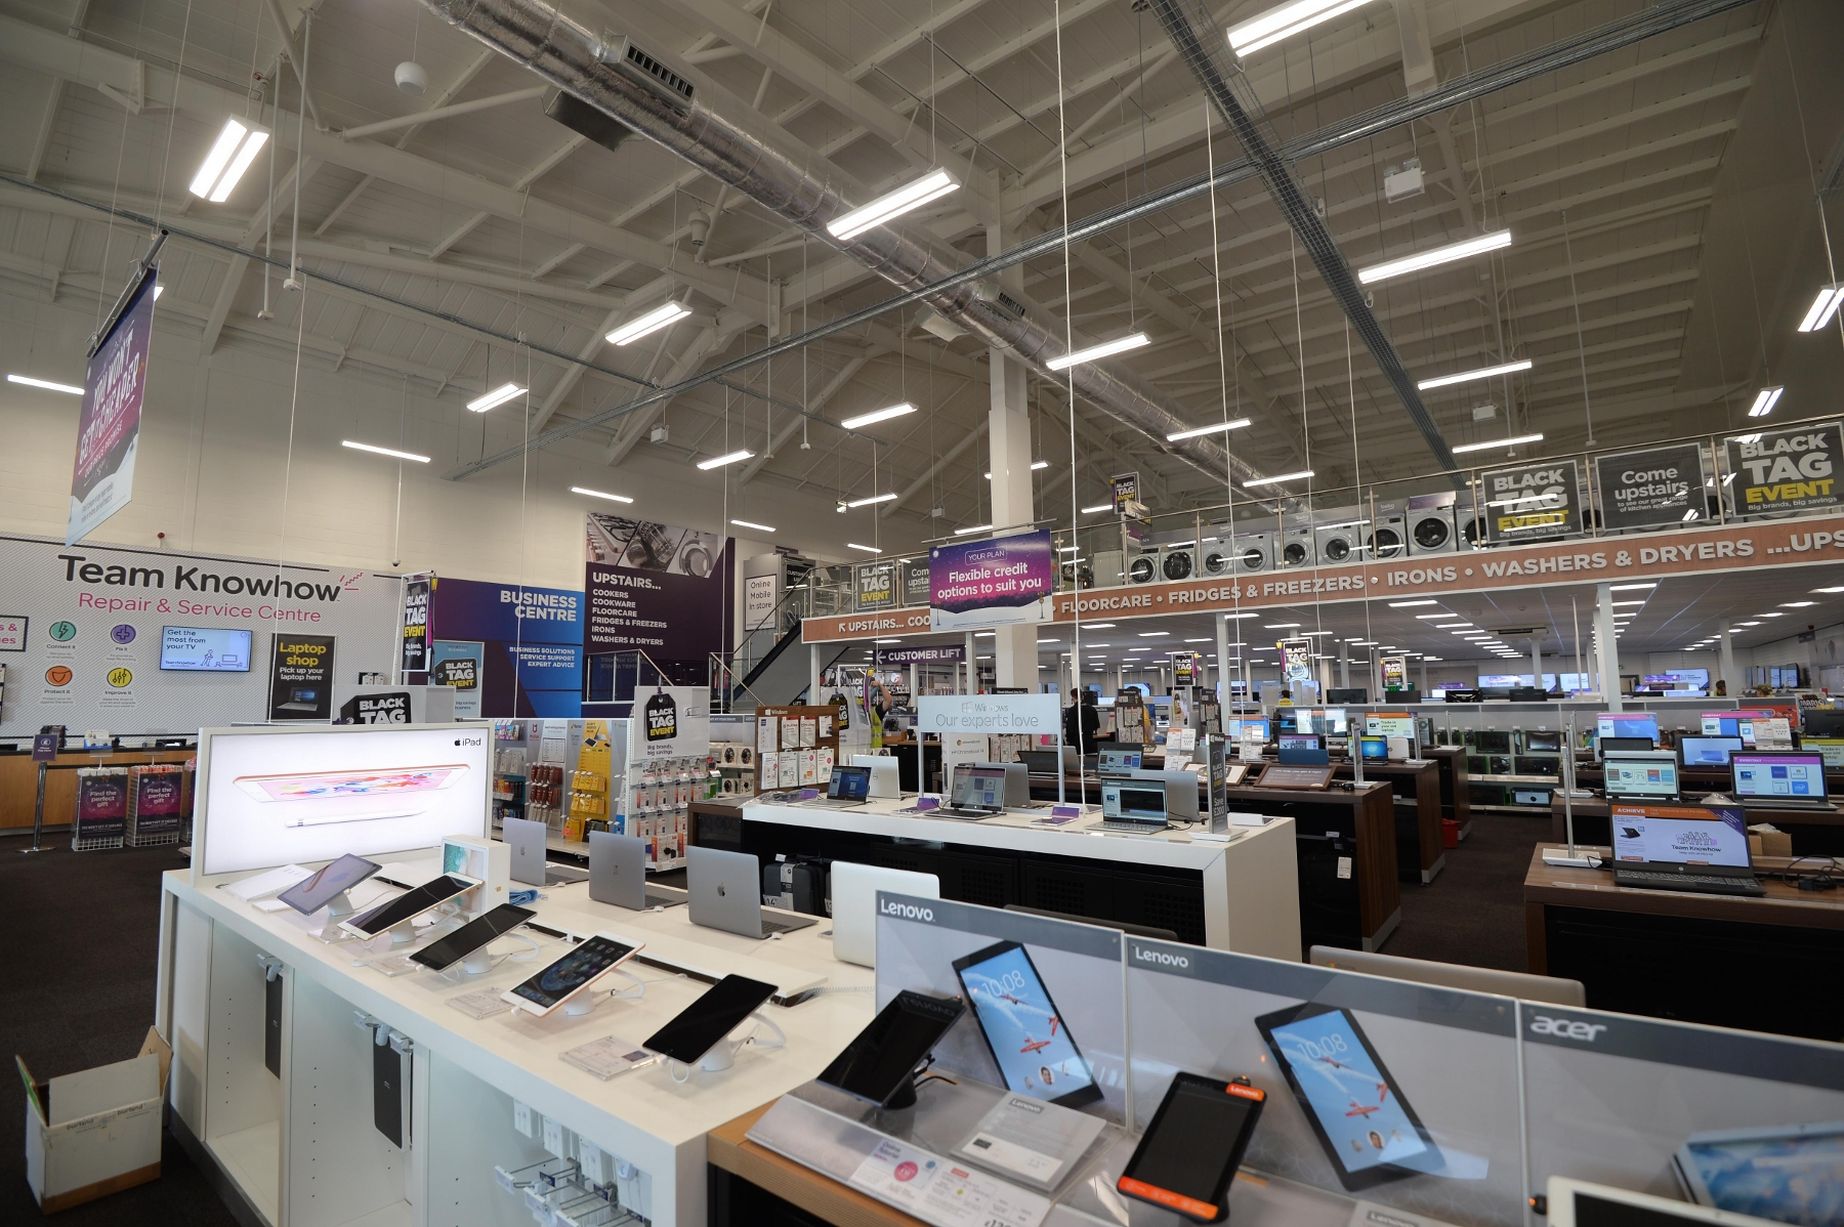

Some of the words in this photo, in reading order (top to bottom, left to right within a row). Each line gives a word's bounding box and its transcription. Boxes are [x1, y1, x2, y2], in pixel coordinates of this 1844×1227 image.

[1740, 433, 1828, 458] BLACK
[1742, 452, 1832, 484] TAG
[1494, 469, 1566, 491] BLACK
[1622, 468, 1678, 484] Come
[1117, 486, 1134, 496] TAG
[1614, 480, 1688, 502] upstairs
[1746, 479, 1834, 504] EVENT
[1496, 486, 1568, 514] TAG
[1808, 496, 1837, 505] savings
[1498, 510, 1568, 531] EVENT
[968, 552, 986, 562] YOUR
[987, 550, 1004, 558] PLAN
[1388, 566, 1458, 586] IRONS
[1482, 552, 1608, 578] WASHERS
[1615, 550, 1632, 567] &
[1640, 540, 1754, 564] DRYERS
[861, 565, 889, 577] BLACK
[912, 568, 929, 577] Com
[949, 568, 990, 584] Flexible
[994, 562, 1028, 578] credit
[58, 554, 164, 588] Team
[174, 565, 341, 602] Knowhow
[861, 575, 890, 592] TAG
[592, 588, 629, 598] COOKERS
[938, 585, 978, 600] options
[981, 584, 993, 594] to
[996, 579, 1016, 592] suit
[1020, 578, 1042, 592] you
[1062, 595, 1152, 614] FLOORCARE
[1169, 586, 1242, 604] FRIDGES
[1246, 585, 1258, 598] &
[1264, 576, 1364, 596] FREEZERS
[406, 594, 427, 606] BLACK
[500, 590, 576, 608] BUSINESS
[861, 590, 890, 602] EVENT
[79, 592, 152, 614] Repair
[156, 598, 171, 613] &
[178, 600, 252, 619] Service
[258, 605, 322, 622] Centre
[592, 598, 636, 608] COOKWARE
[406, 606, 426, 626] TAG
[514, 606, 576, 622] CENTRE
[592, 607, 638, 618] FLOORCARE
[8, 623, 18, 632] &
[592, 617, 624, 626] FRIDGES
[632, 620, 668, 628] FREEZERS
[908, 616, 930, 626] COO
[404, 626, 426, 638] EVENT
[592, 626, 616, 634] IRONS
[592, 635, 628, 644] WASHERS
[280, 642, 326, 655] Laptop
[888, 650, 938, 660] CUSTOMER
[940, 648, 960, 658] LIFT
[286, 655, 318, 667] shop
[1286, 653, 1308, 663] TAG
[445, 661, 474, 670] BLACK
[446, 669, 474, 680] TAG
[360, 697, 405, 710] BLACK
[360, 708, 406, 724] TAG
[649, 708, 674, 717] BLACK
[650, 715, 674, 728] TAG
[936, 713, 957, 727] Our
[961, 714, 1008, 728] experts
[1011, 713, 1039, 727] love
[650, 726, 674, 736] EVENT
[462, 738, 482, 747] iPad
[880, 898, 934, 922] Lenovo
[1135, 946, 1188, 968] Lenovo
[982, 970, 1026, 998] 10:08
[1530, 1015, 1606, 1042] acer
[1297, 1034, 1348, 1059] 10:08
[1231, 1086, 1258, 1096] Lenovo
[1012, 1099, 1040, 1112] Lenovo
